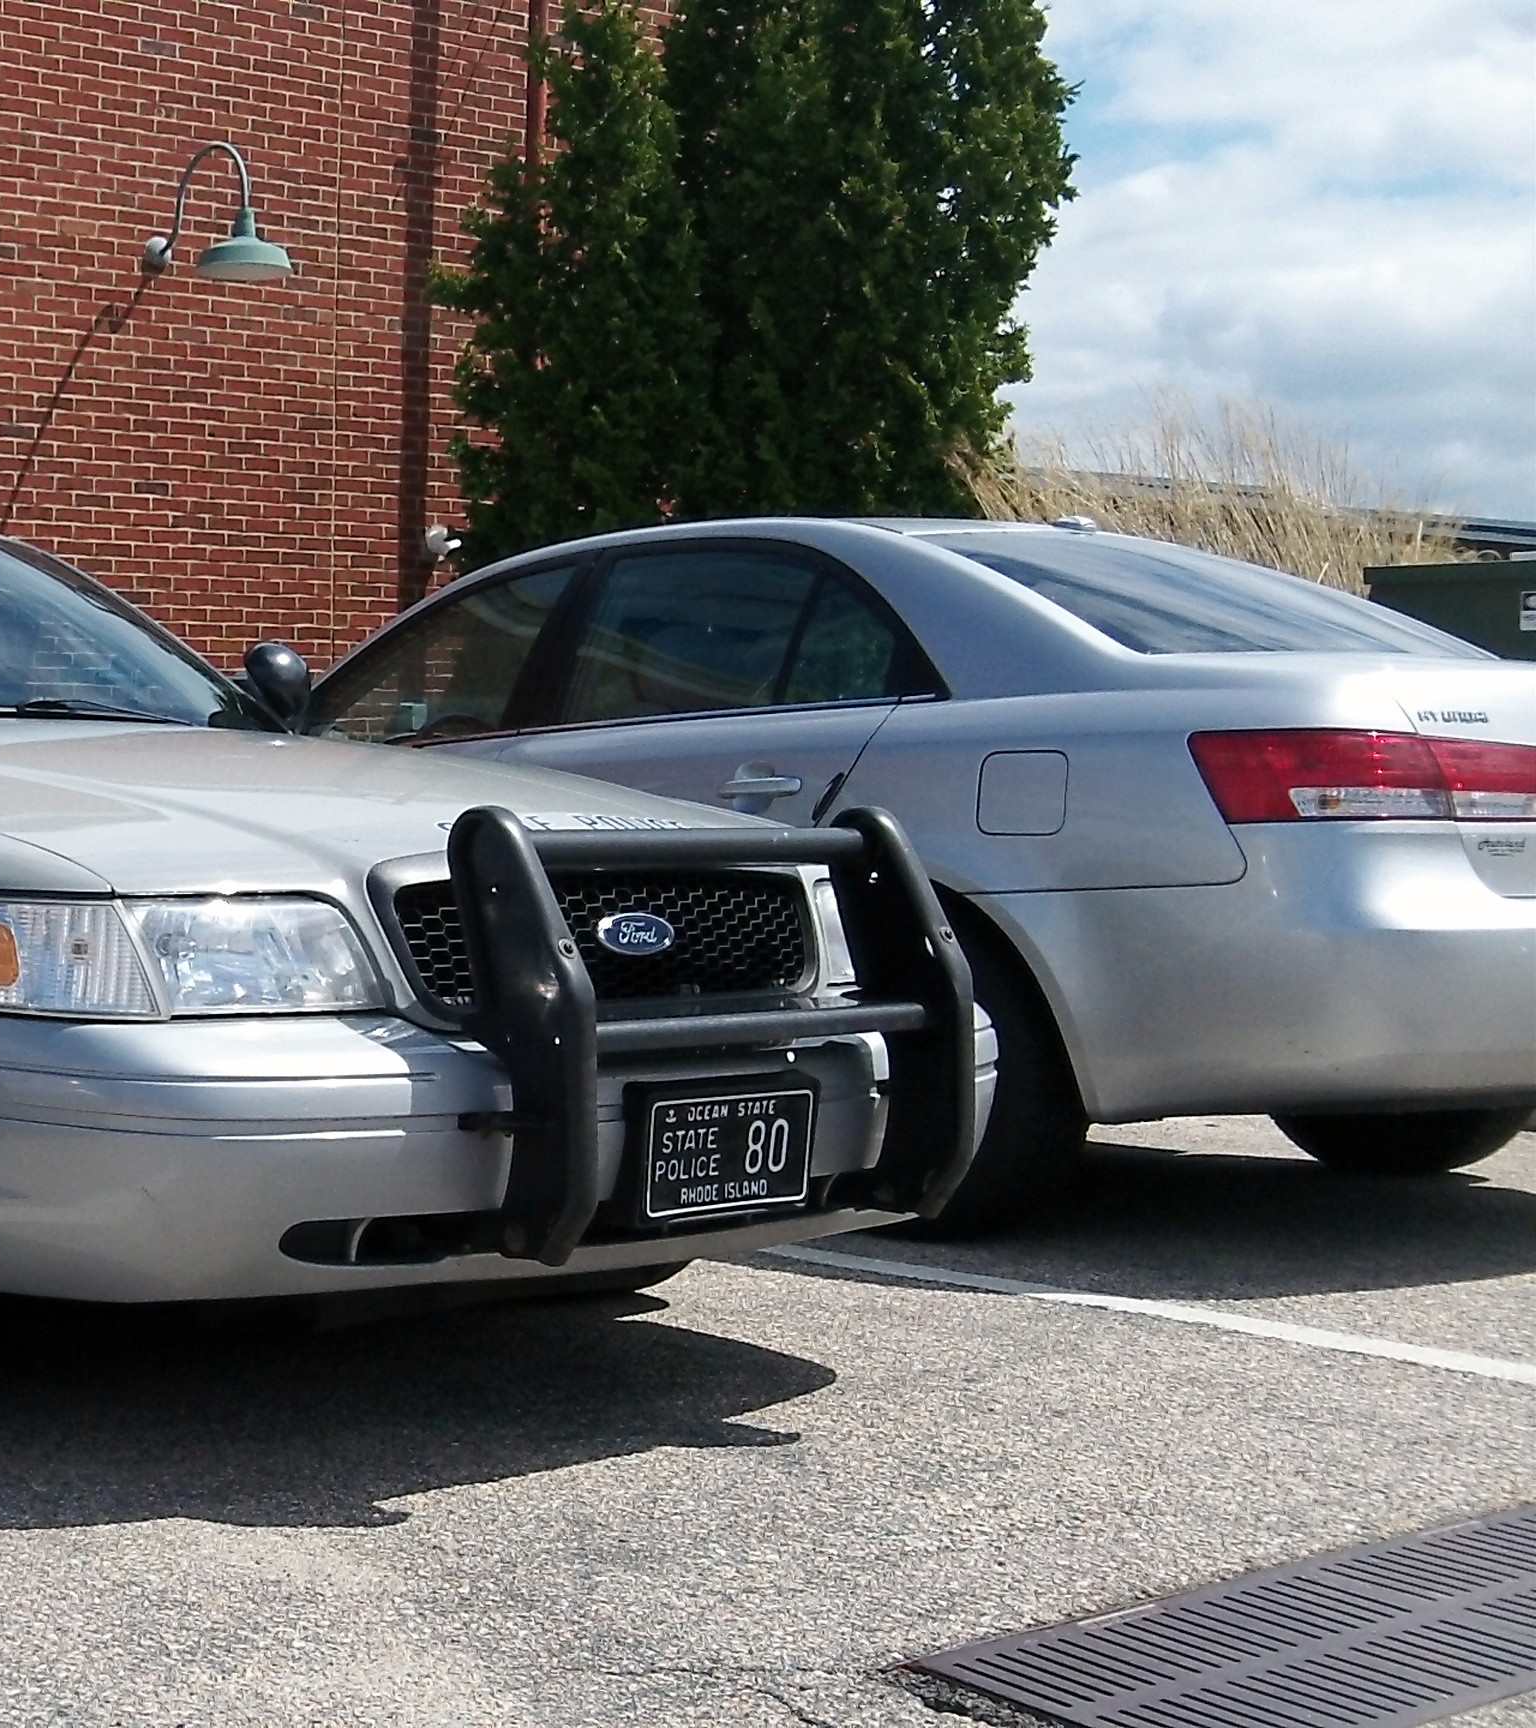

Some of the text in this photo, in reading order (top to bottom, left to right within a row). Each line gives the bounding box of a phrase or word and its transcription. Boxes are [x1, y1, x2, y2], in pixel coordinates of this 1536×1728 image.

[618, 920, 658, 944] Ford
[686, 1099, 777, 1122] OCEAN STATE
[661, 1126, 720, 1154] STATE
[744, 1117, 790, 1175] 80
[654, 1153, 722, 1184] POLICE
[679, 1178, 768, 1205] RHODE ISLAND
